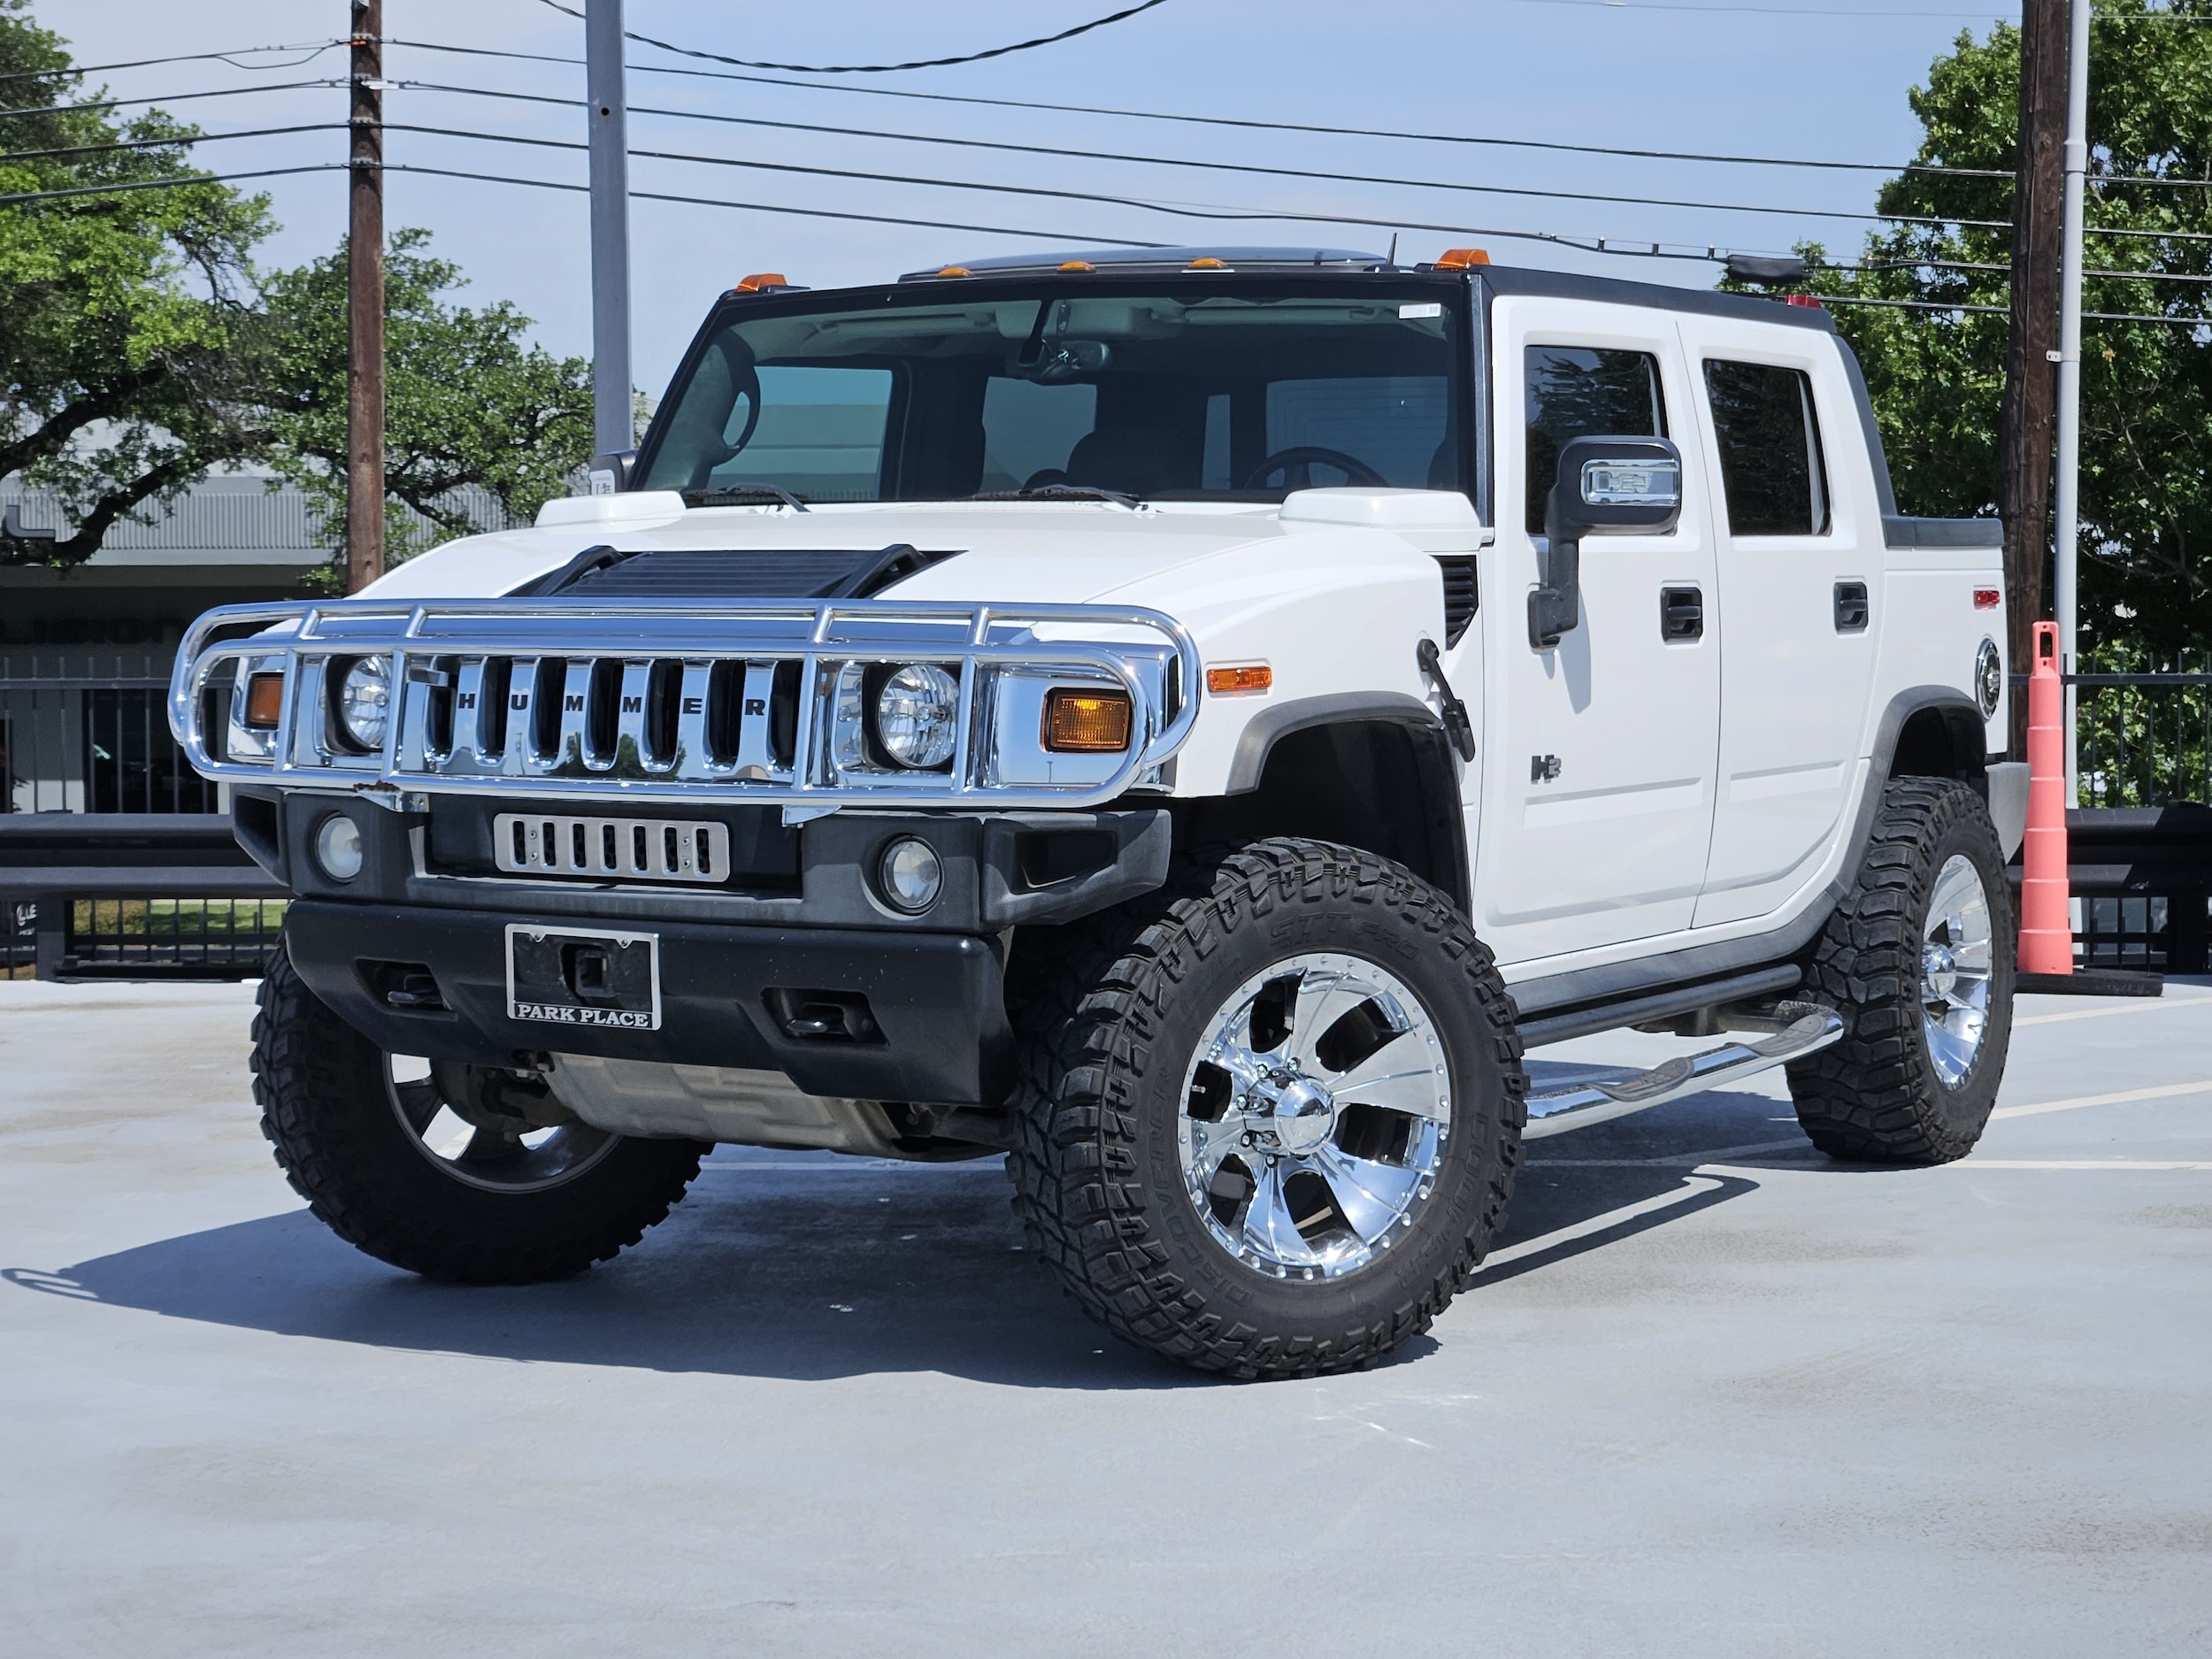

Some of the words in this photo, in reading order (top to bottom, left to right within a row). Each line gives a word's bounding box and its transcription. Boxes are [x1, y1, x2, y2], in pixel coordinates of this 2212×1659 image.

[458, 693, 766, 717] HUMMER
[1531, 755, 1562, 782] H2
[518, 1003, 577, 1023] PARK
[580, 1009, 649, 1028] PLACE
